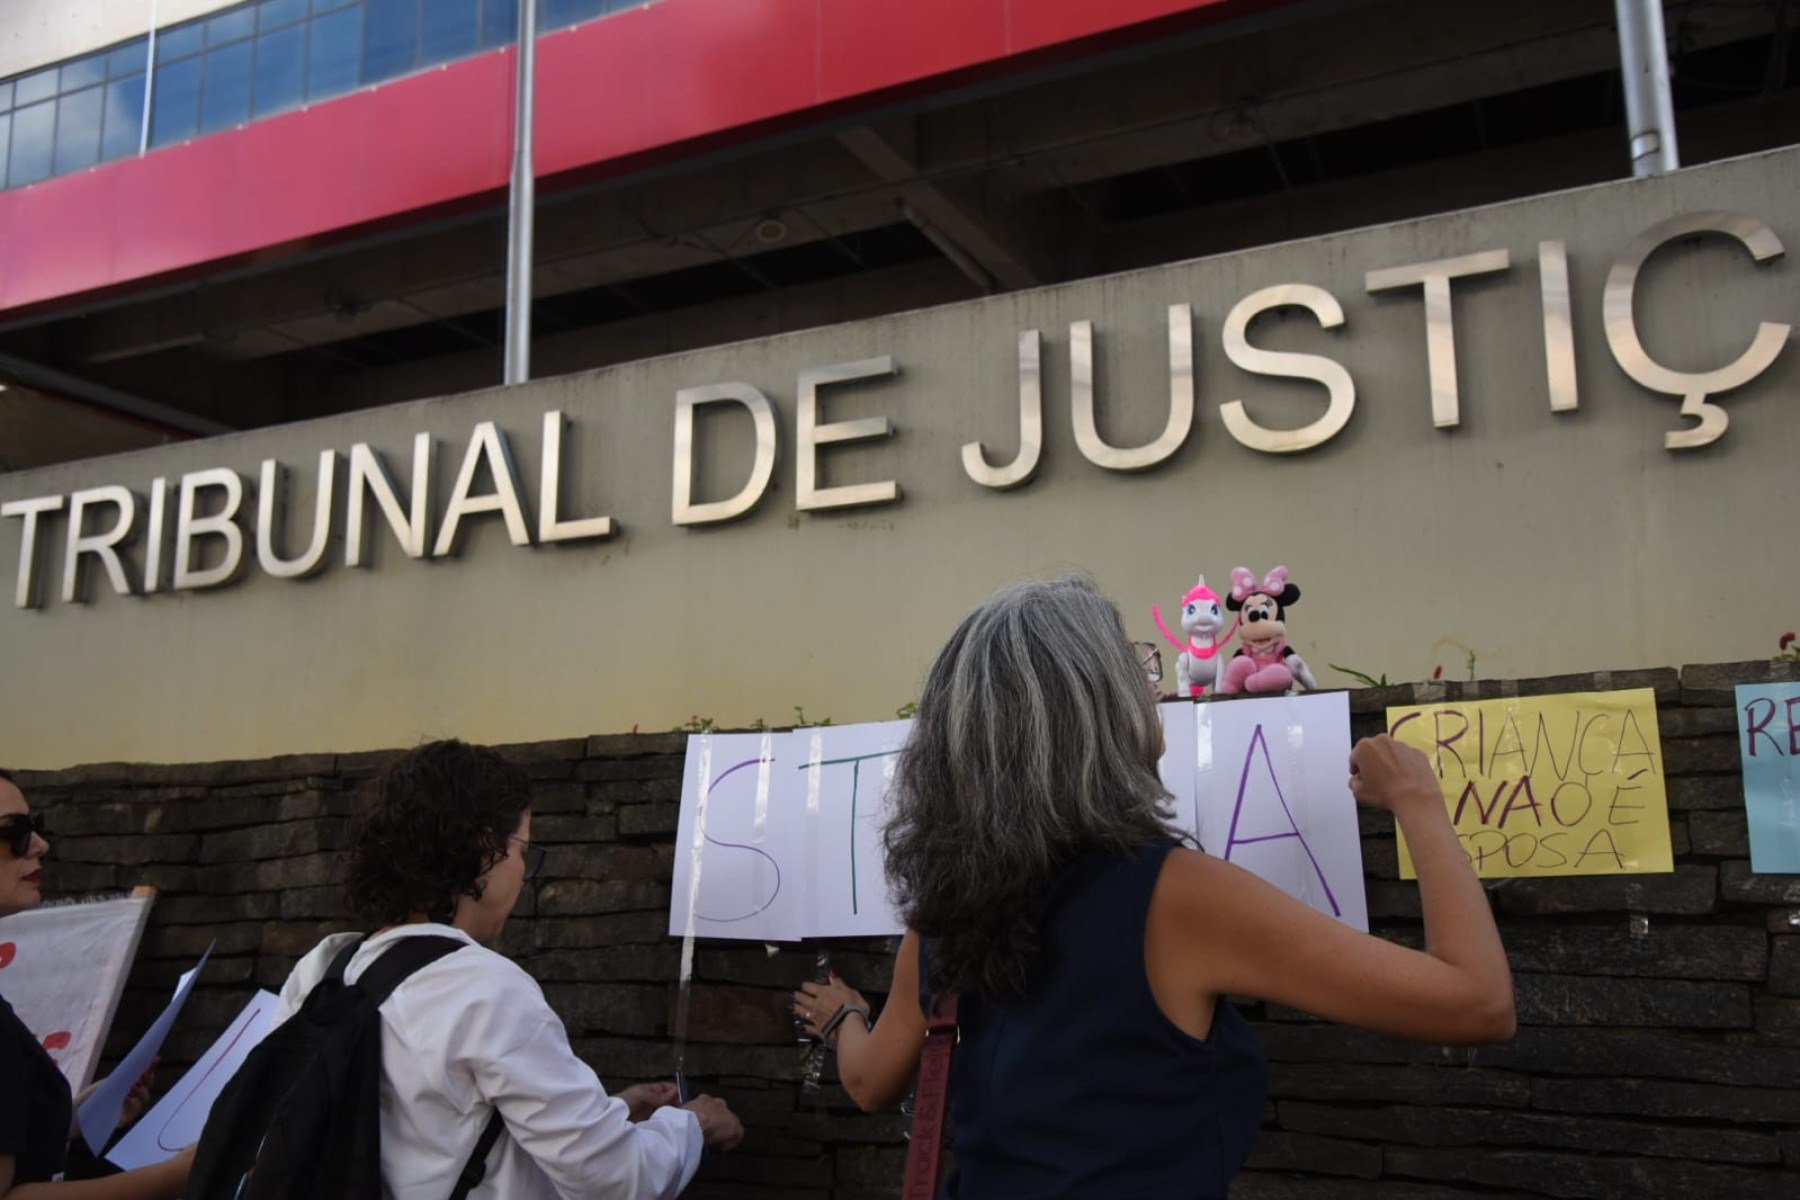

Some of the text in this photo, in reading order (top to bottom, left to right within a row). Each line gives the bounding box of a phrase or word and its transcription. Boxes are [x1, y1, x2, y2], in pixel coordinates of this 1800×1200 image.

[1, 210, 1792, 609] TRIBUNAL DE JUSTIÇ
[1608, 768, 1649, 826] É
